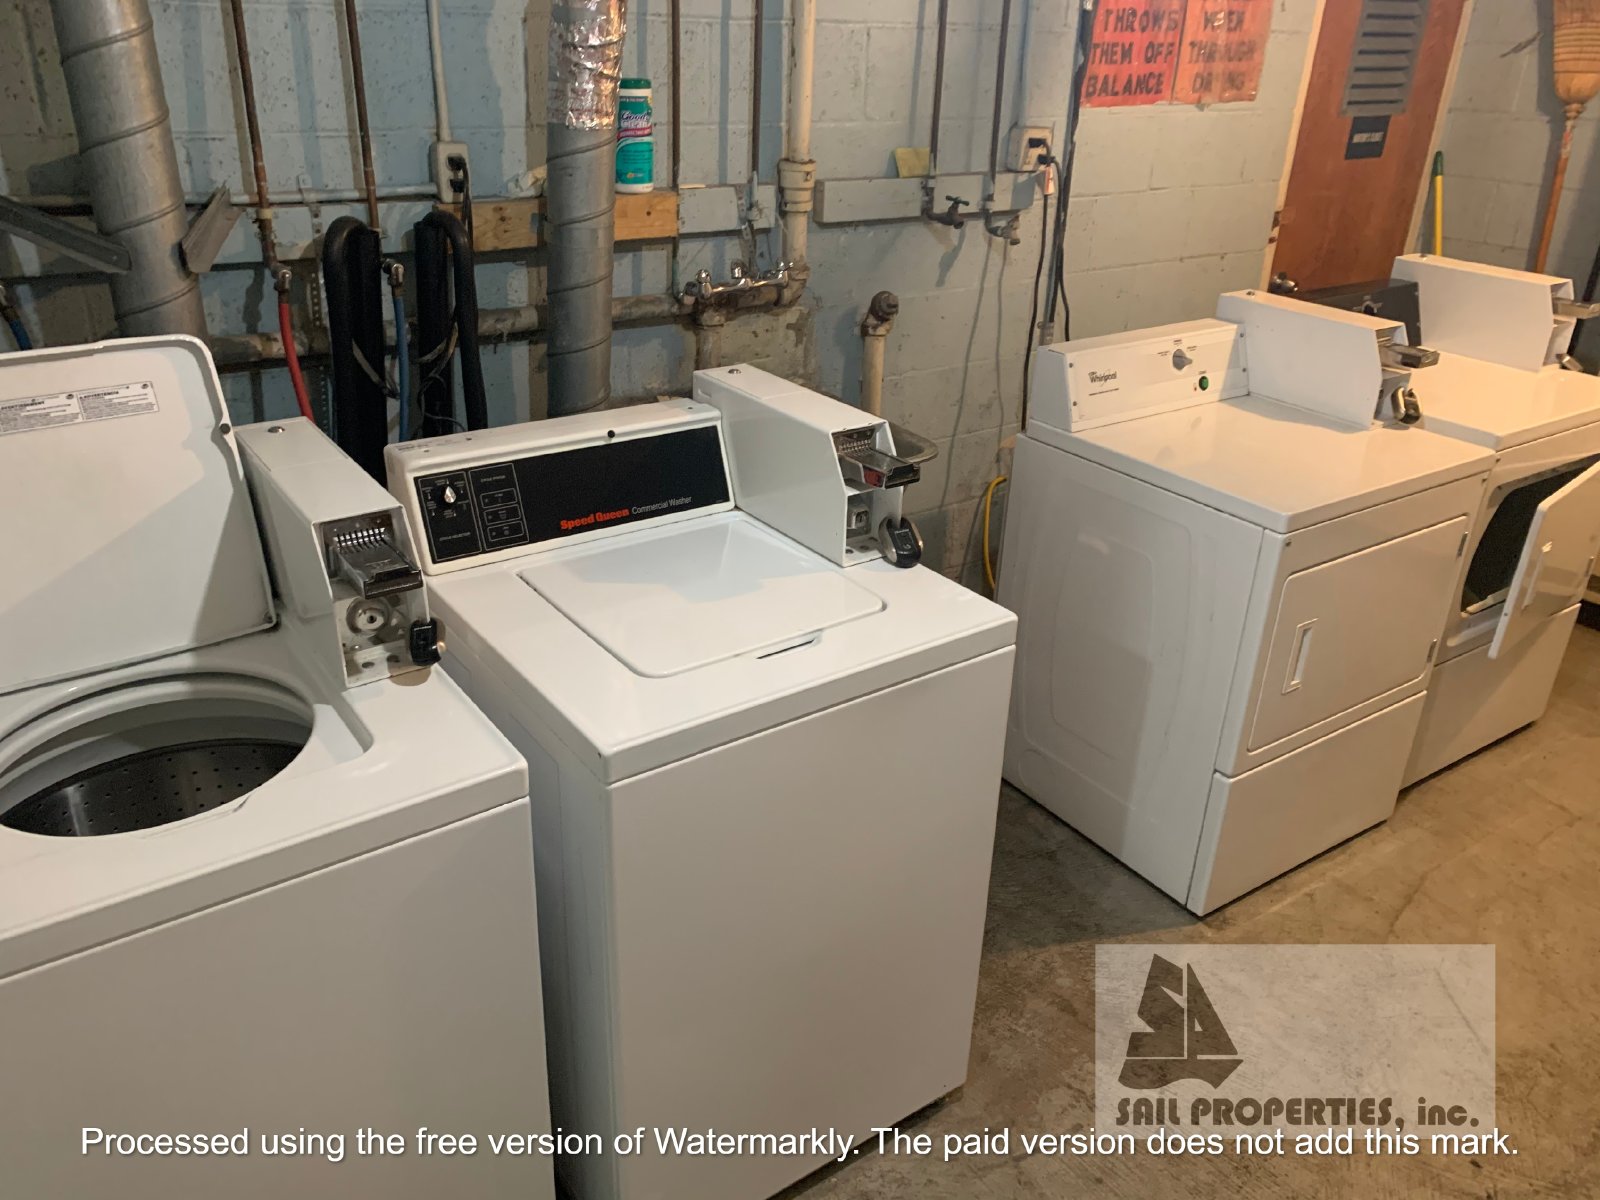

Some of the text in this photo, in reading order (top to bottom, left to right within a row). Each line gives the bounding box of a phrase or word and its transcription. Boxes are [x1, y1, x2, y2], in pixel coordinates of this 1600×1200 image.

[1102, 8, 1180, 33] THROWS
[1203, 10, 1246, 33] WEN
[1090, 41, 1175, 65] THEM OFF
[1188, 40, 1257, 65] THRUGH
[1085, 72, 1165, 97] BALANCE
[1191, 72, 1247, 94] DRNG
[560, 496, 692, 530] Speed Queen Commercial Washer
